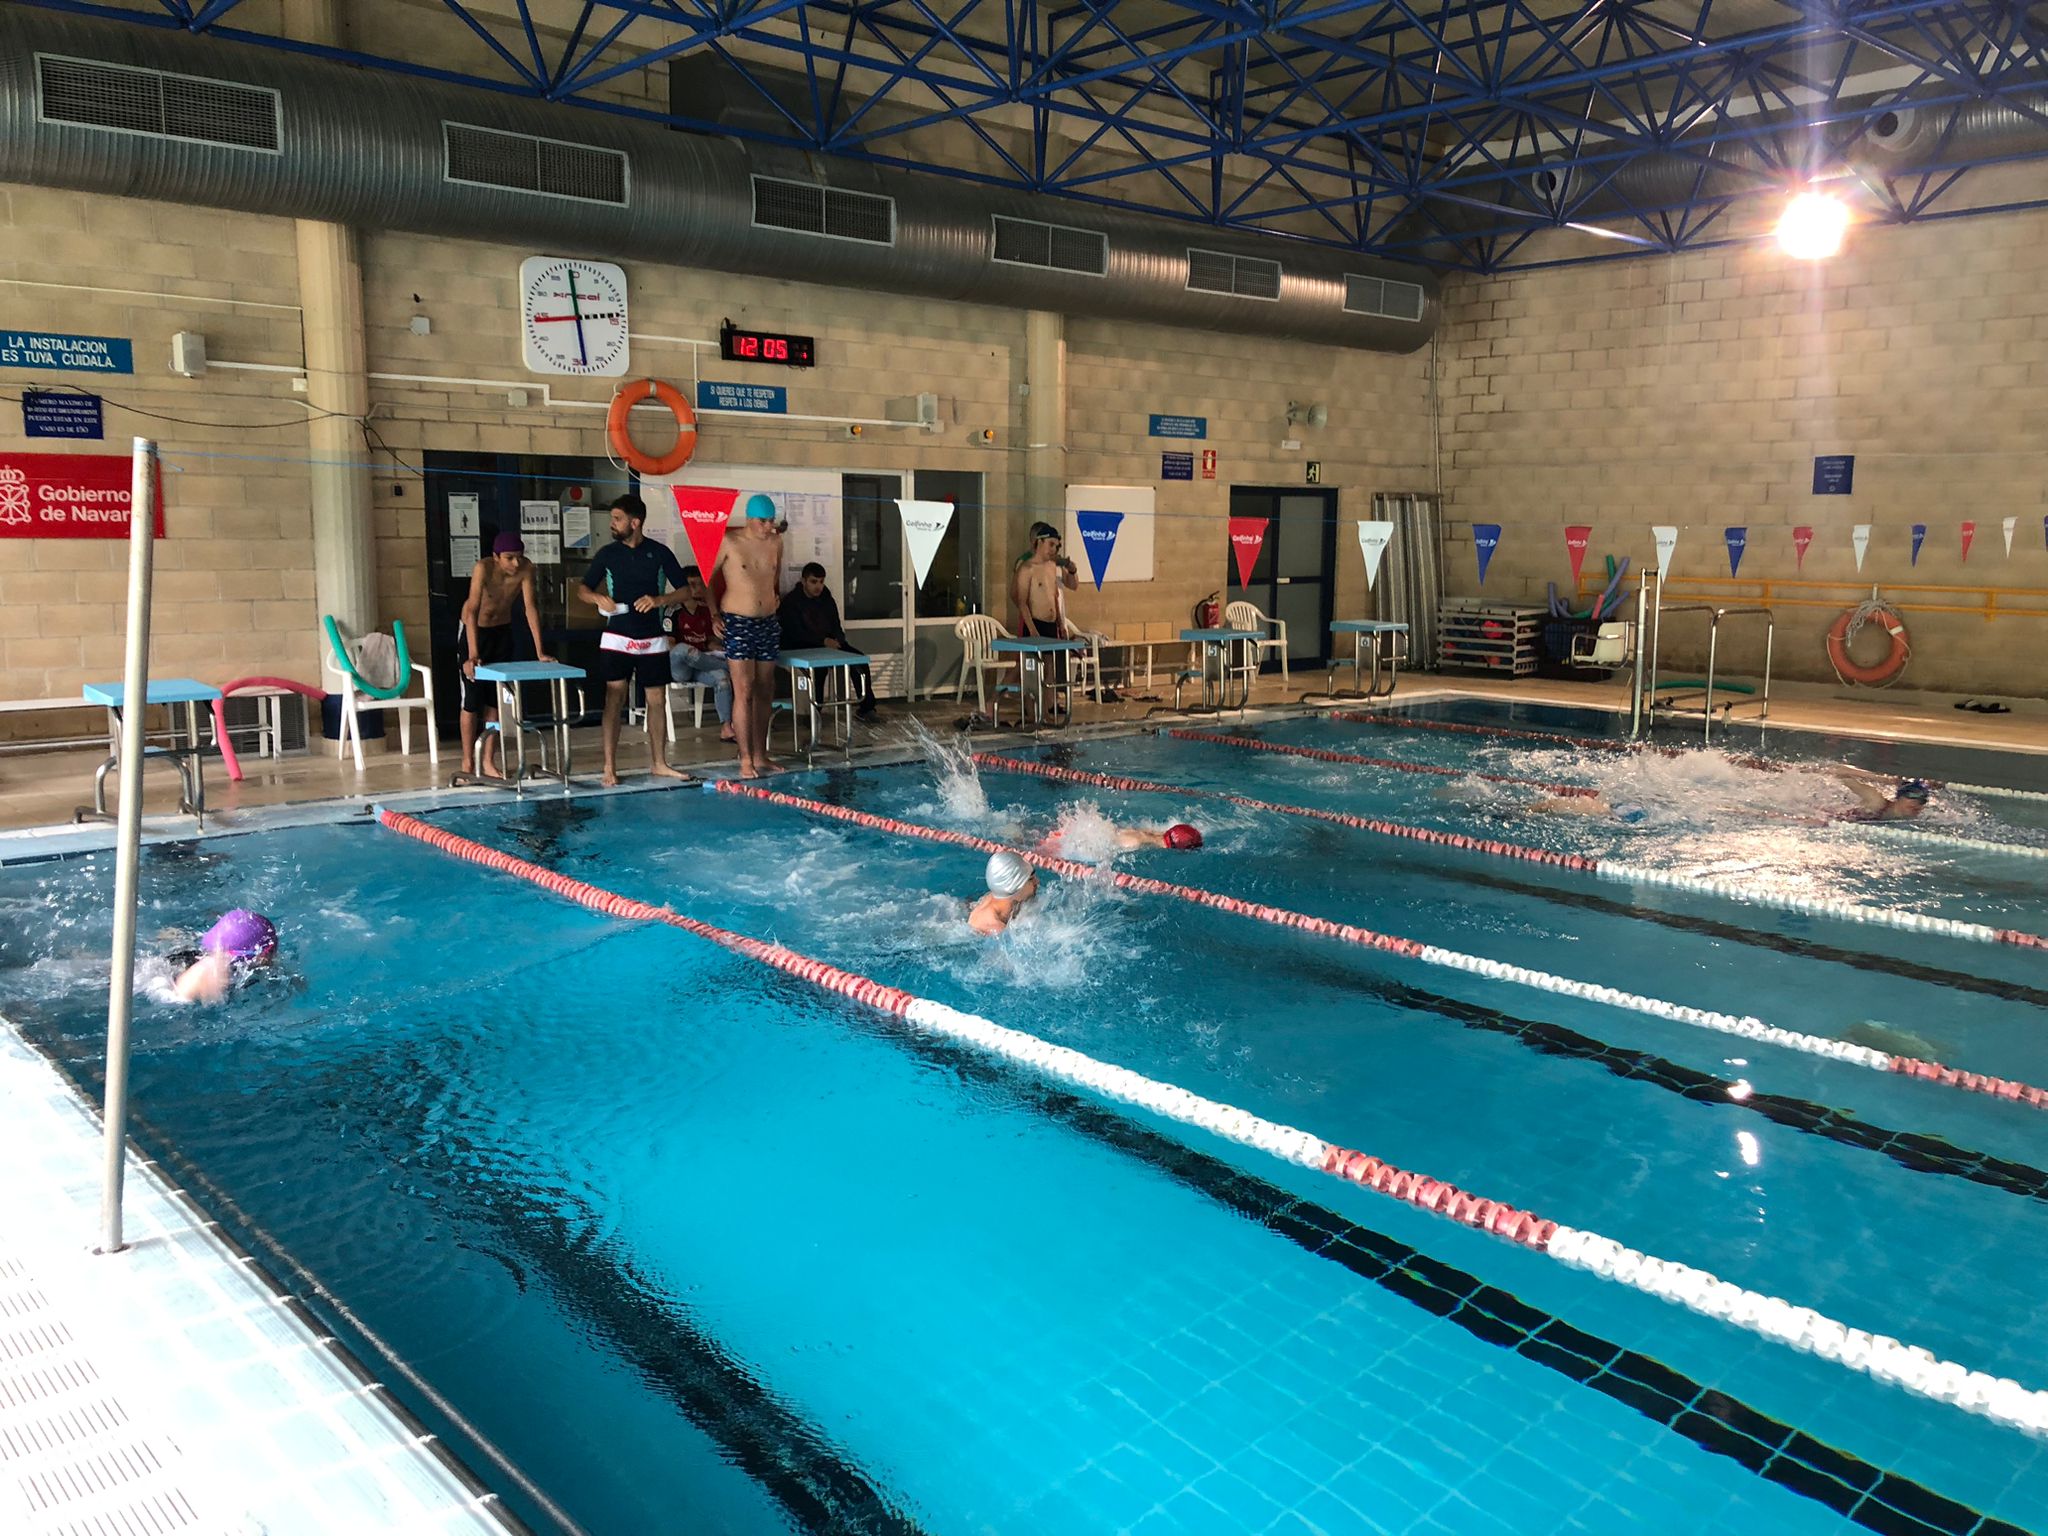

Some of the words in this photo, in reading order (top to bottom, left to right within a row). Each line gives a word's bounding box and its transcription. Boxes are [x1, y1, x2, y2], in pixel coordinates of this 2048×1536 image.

[8, 336, 25, 349] LA
[29, 337, 108, 354] INSTALACION
[1, 349, 19, 362] ES
[23, 350, 58, 366] TUYA,
[61, 353, 116, 368] CUIDALA.
[736, 386, 746, 398] QUE
[38, 485, 131, 502] Gobierno
[39, 505, 66, 521] de
[71, 505, 131, 522] Navar
